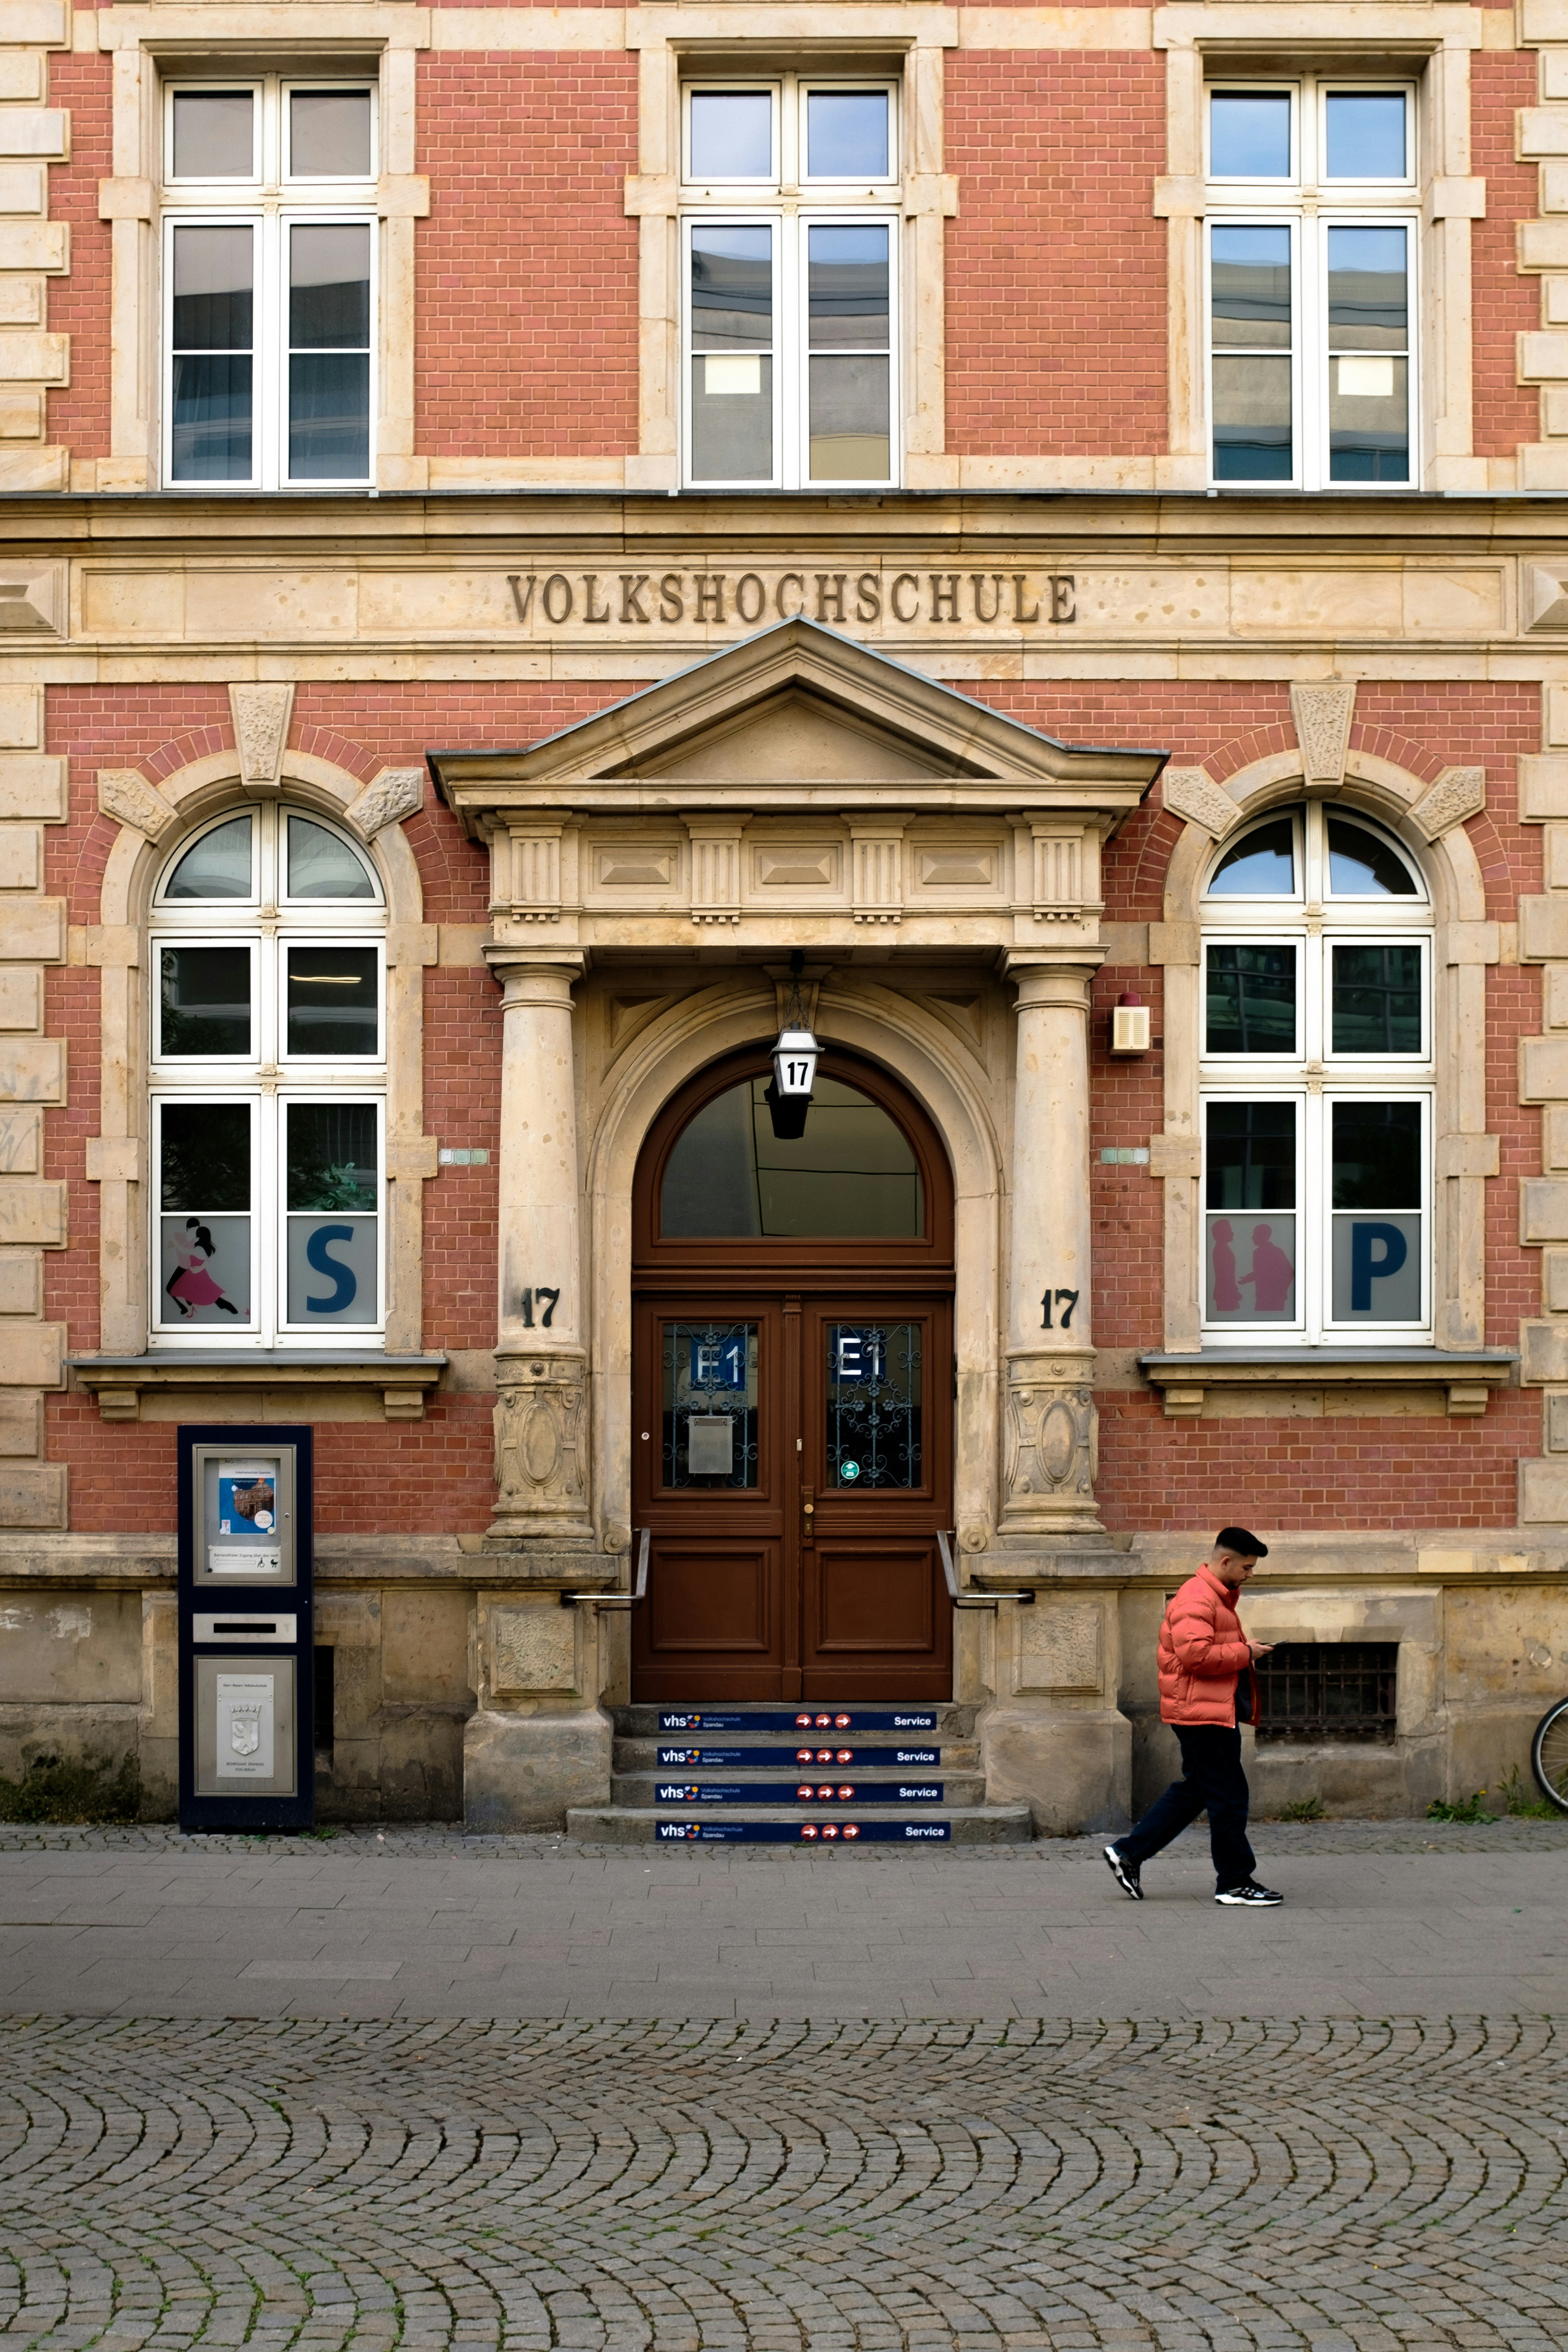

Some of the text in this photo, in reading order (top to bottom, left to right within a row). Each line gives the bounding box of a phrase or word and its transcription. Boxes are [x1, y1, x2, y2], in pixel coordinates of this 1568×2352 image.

[507, 572, 1076, 623] VOLKSHOCHSCHULE
[788, 1062, 808, 1086] 17
[306, 1224, 357, 1313] S
[1351, 1222, 1407, 1311] P
[521, 1287, 560, 1328] 17
[1040, 1289, 1079, 1328] 17
[698, 1345, 738, 1383] E1
[839, 1338, 879, 1375] E1
[664, 1715, 687, 1727] vhs
[894, 1717, 931, 1726] Service
[662, 1749, 686, 1762] vhs
[897, 1752, 935, 1761] Service
[660, 1786, 684, 1798] vhs
[899, 1788, 938, 1797] Service
[661, 1824, 685, 1837] vhs
[906, 1827, 944, 1836] Service
